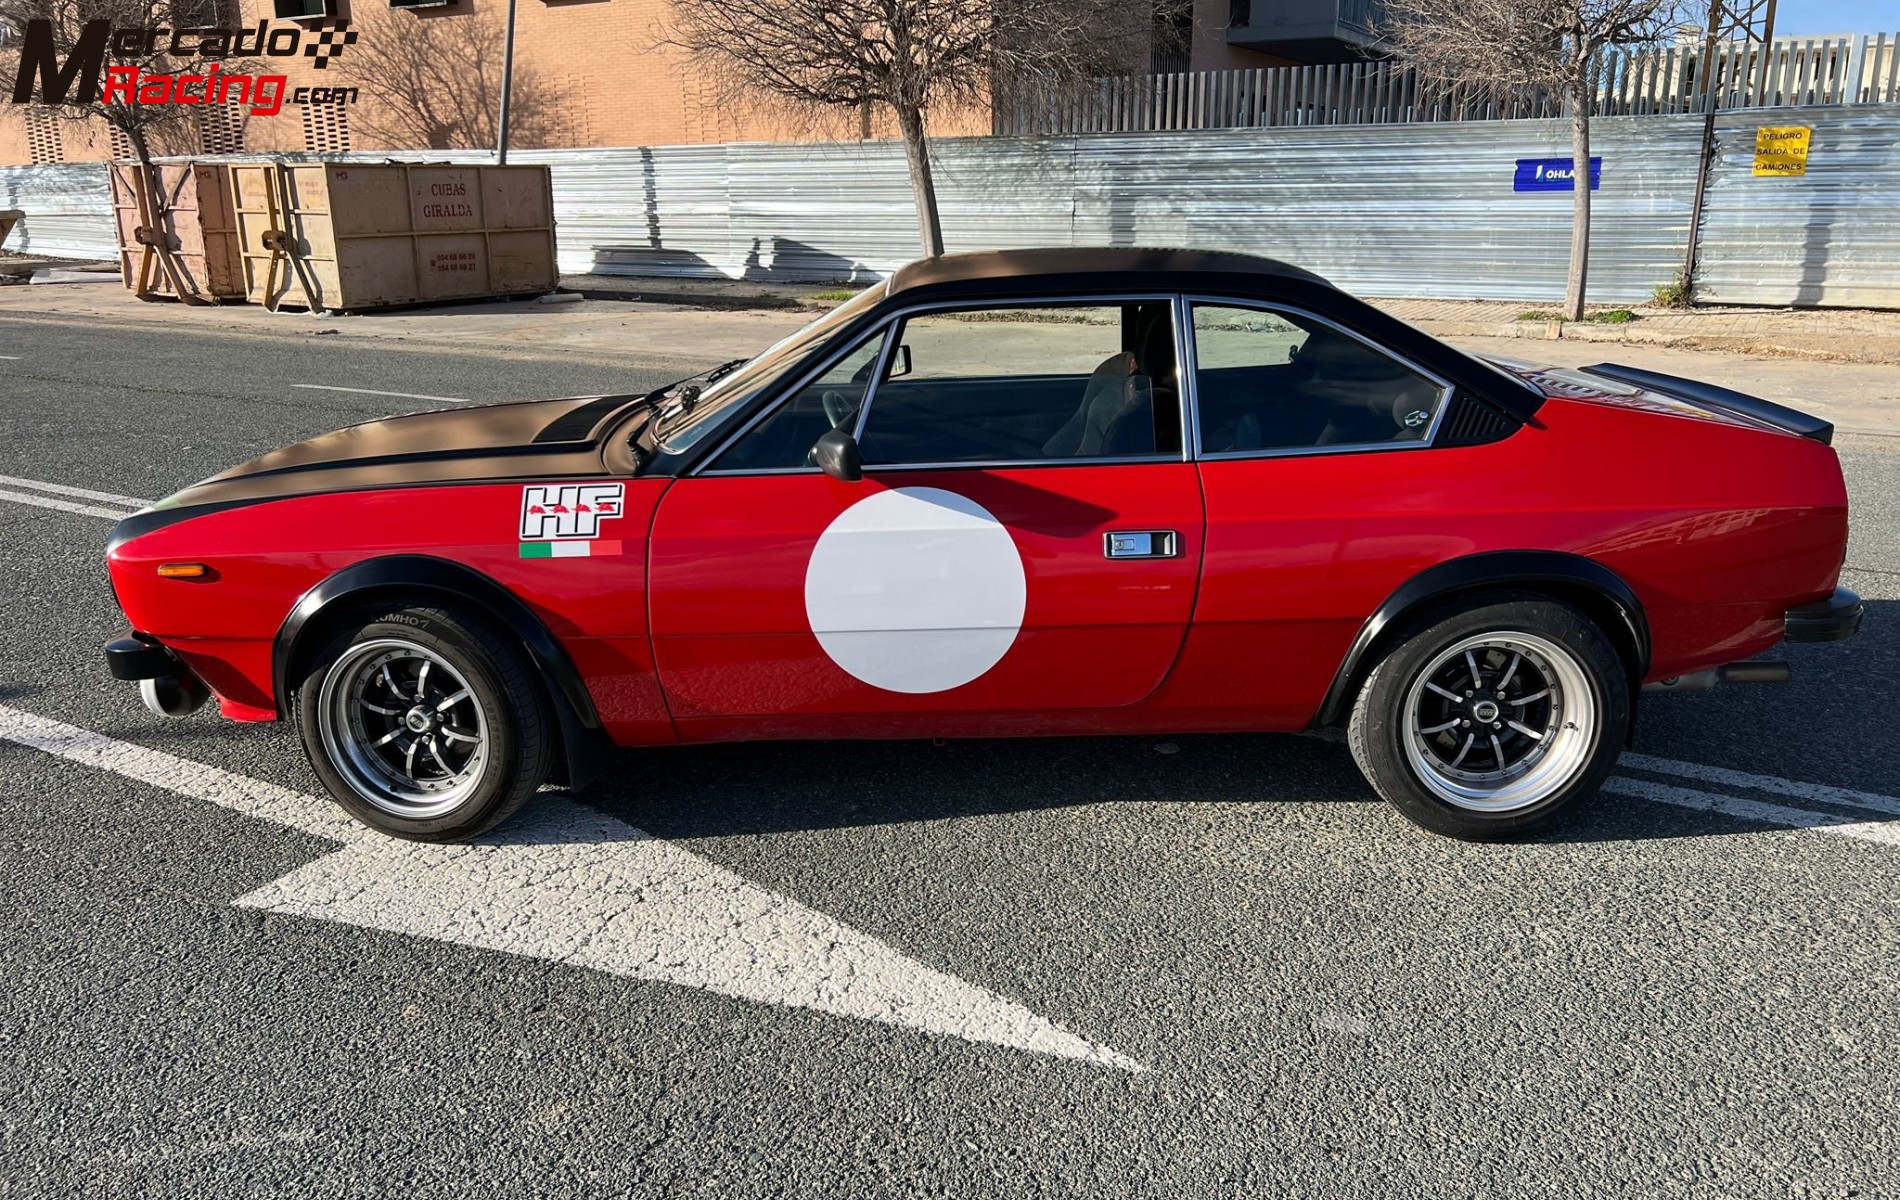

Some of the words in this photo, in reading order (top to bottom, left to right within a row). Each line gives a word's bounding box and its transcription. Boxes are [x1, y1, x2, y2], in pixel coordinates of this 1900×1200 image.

[1763, 132, 1803, 140] PELIGRO
[1756, 148, 1789, 156] SALIDA
[1793, 147, 1806, 155] DE
[1755, 163, 1803, 171] CAMIONES
[1545, 169, 1575, 179] OHLA
[431, 183, 467, 197] CUBAS
[423, 203, 473, 218] GIRALDA
[521, 484, 623, 538] HF
